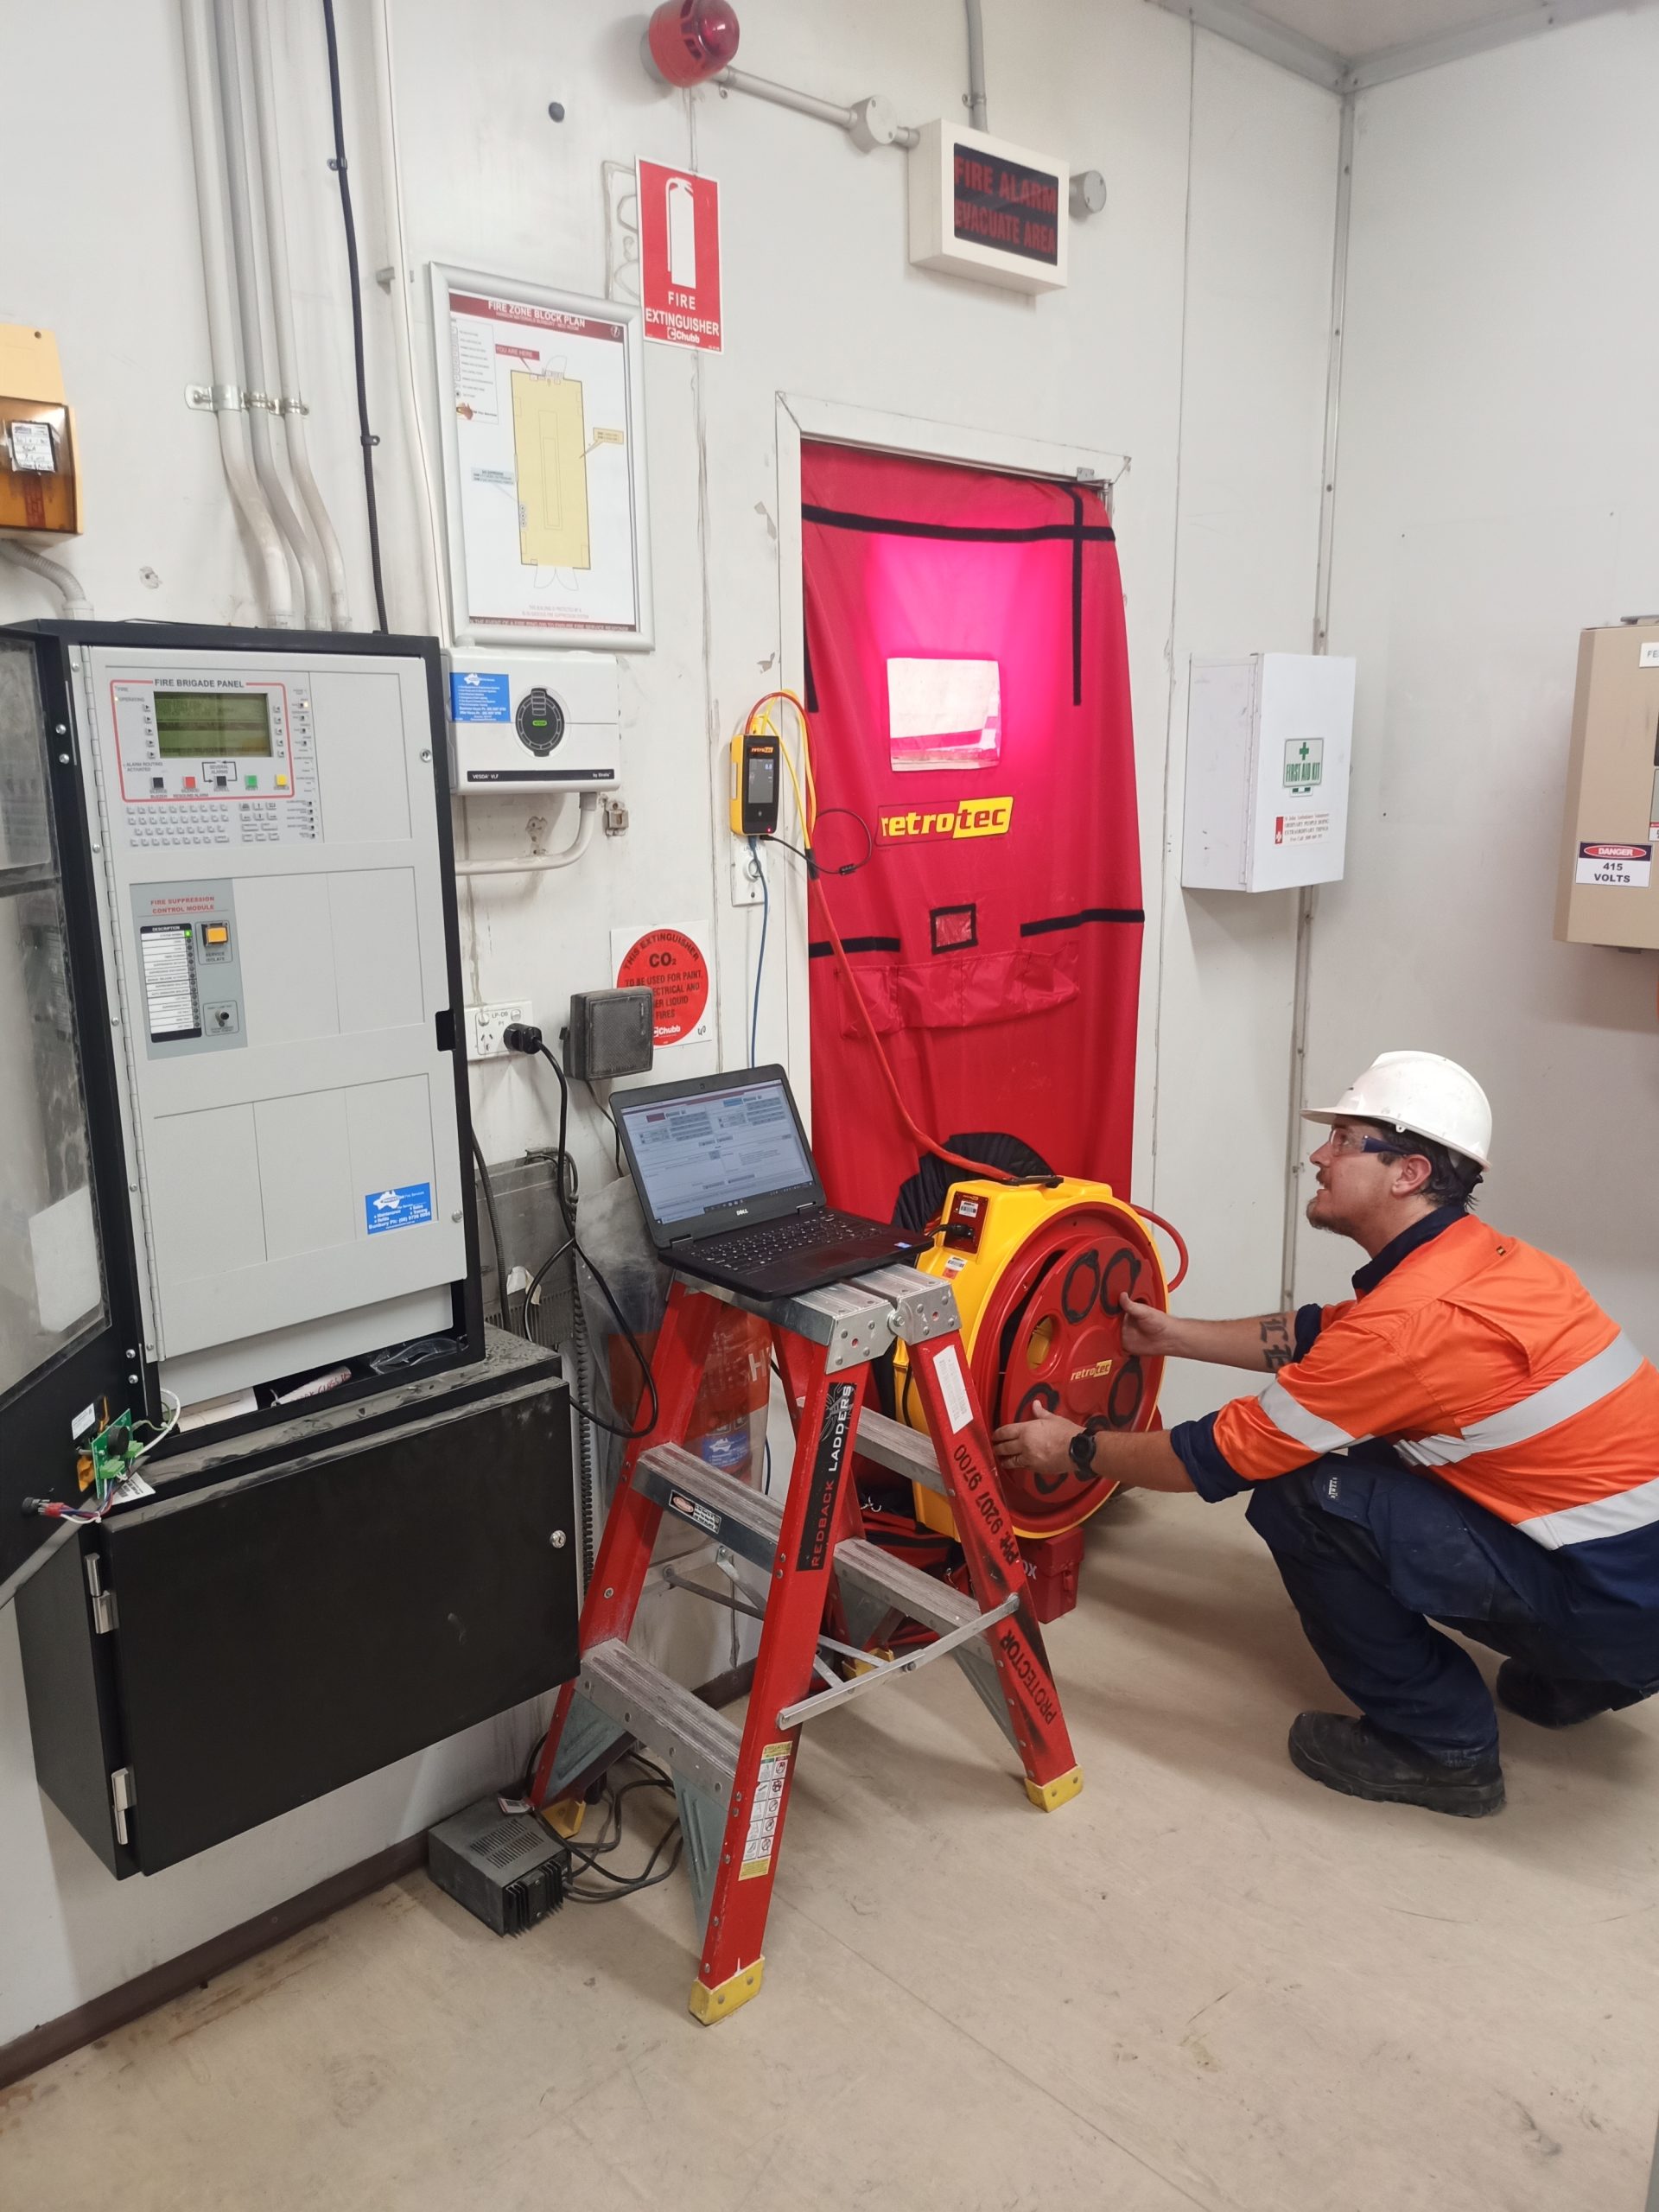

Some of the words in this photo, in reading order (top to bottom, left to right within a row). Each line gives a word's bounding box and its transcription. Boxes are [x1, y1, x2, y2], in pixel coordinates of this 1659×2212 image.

[954, 155, 993, 194] FIRE
[999, 171, 1056, 214] ALARM
[954, 199, 1020, 245] EVACUATE
[1023, 221, 1056, 255] AREA
[668, 290, 696, 310] FIRE
[488, 301, 507, 312] FIRE
[509, 304, 531, 318] ZONE
[534, 309, 562, 323] BLOCK
[564, 315, 586, 327] PLAN
[645, 308, 720, 336] EXTINGUISHER
[676, 330, 701, 343] Chubb
[176, 679, 215, 688] BRIGADE
[1286, 763, 1301, 782] FIRST
[880, 804, 1010, 838] retrotec
[1598, 848, 1633, 856] DANGER
[1603, 862, 1623, 871] 415
[1594, 874, 1630, 883] VOLTS
[623, 948, 640, 969] THIS
[640, 932, 699, 961] EXTINGUISHER
[636, 977, 645, 986] BE
[646, 975, 665, 985] USED
[667, 972, 681, 983] FOR
[653, 985, 684, 996] ECTRICAL
[686, 982, 700, 992] AND
[666, 995, 689, 1007] LIQUID
[656, 1009, 676, 1020] FIRES
[658, 1025, 681, 1035] Chubb
[1071, 1361, 1111, 1381] retrotec
[811, 1479, 835, 1567] REDBACK
[829, 1385, 851, 1471] LADDERS
[954, 1444, 982, 1491] 9700
[1000, 1630, 1057, 1725] PROTECTOR
